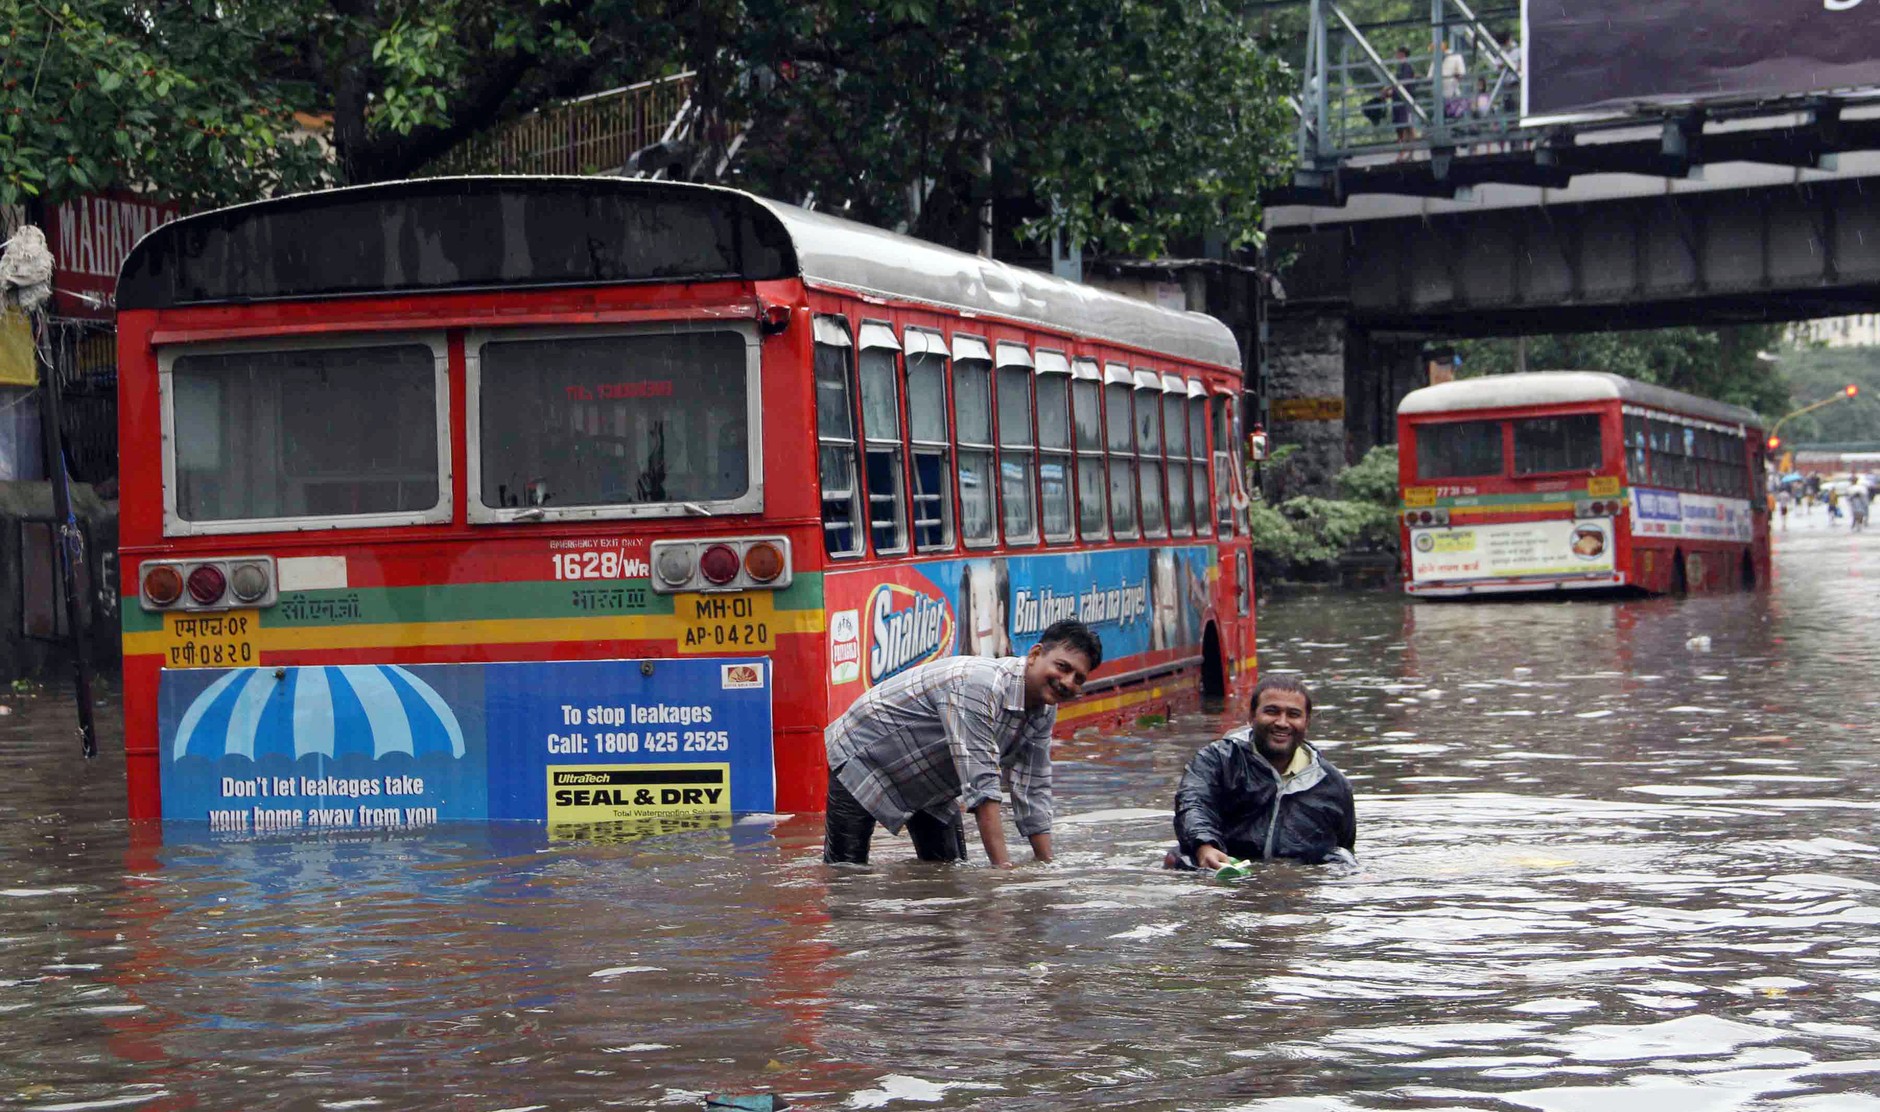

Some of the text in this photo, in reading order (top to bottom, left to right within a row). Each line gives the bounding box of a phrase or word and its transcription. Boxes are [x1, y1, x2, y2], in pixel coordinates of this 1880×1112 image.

[549, 539, 598, 550] EMERGENCY
[600, 538, 618, 548] EXIT
[1014, 589, 1038, 634] Bin
[1079, 582, 1105, 624] raha
[1107, 590, 1119, 619] na
[870, 586, 945, 682] Snakker
[561, 703, 712, 727] To stop leakages
[547, 731, 729, 754] Call: 1800 425 2525
[272, 776, 296, 797] let
[300, 775, 380, 798] leakages
[384, 775, 424, 796] take
[558, 773, 610, 784] UltraTech
[555, 788, 723, 807] SEAL & DRY
[209, 805, 437, 830] your home away from you
[613, 809, 632, 817] Total
